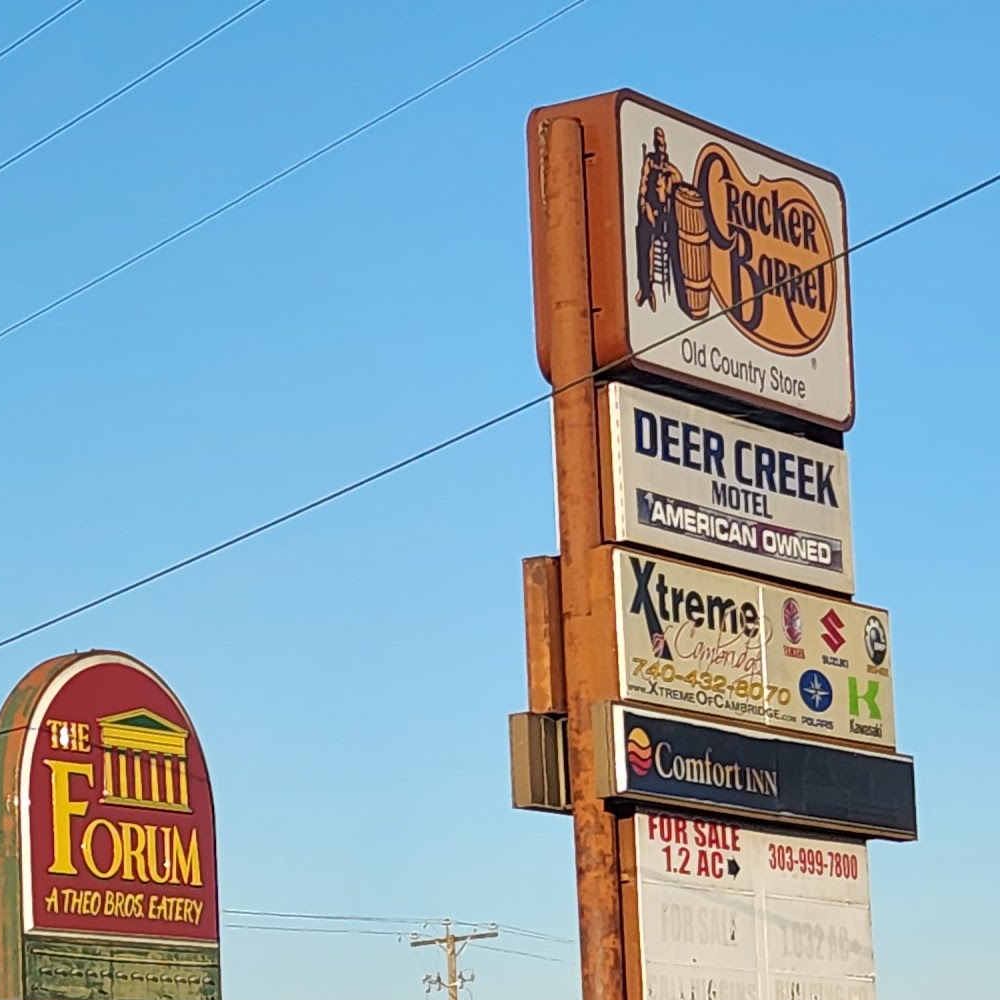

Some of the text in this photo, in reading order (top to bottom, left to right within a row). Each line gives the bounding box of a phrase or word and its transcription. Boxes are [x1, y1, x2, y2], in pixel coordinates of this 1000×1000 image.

[700, 152, 820, 255] Cracker
[729, 227, 827, 333] Barrel
[682, 338, 806, 400] Old Country Store
[633, 406, 839, 509] DEER CREEK
[711, 481, 772, 519] MOTEL
[651, 502, 831, 565] AMERICAN OWNED
[628, 556, 759, 661] Xtreme
[632, 657, 792, 706] 740-432-8070
[46, 718, 91, 753] THE
[655, 742, 778, 797] Comfort INN
[43, 759, 203, 887] FORUM
[648, 814, 741, 852] FOR SALE
[661, 845, 724, 879] 1.2 AC
[768, 843, 858, 880] 303-999-7800
[45, 886, 203, 926] A THEO BROS. EATERY
